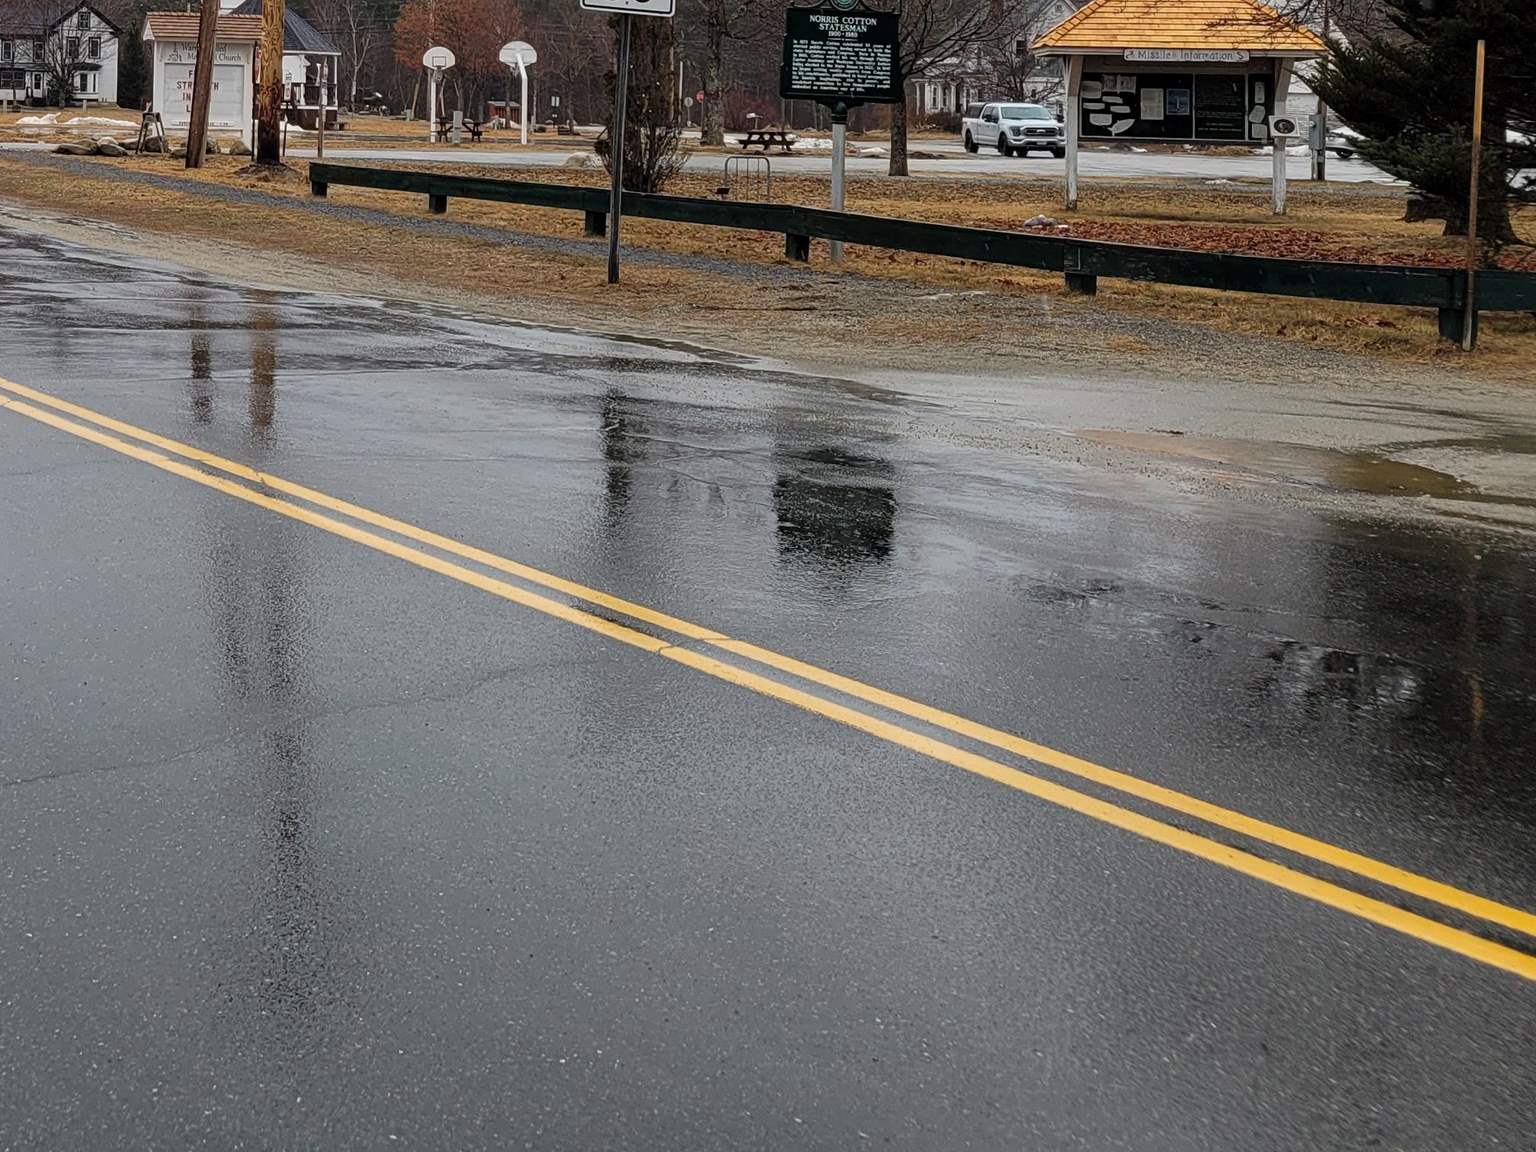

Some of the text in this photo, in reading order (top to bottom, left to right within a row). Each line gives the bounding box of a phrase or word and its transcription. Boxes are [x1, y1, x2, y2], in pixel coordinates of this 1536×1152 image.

[809, 15, 877, 26] NORRIS COTTON
[819, 23, 867, 32] STATESMAN
[218, 52, 241, 62] Church
[1181, 50, 1233, 61] Information
